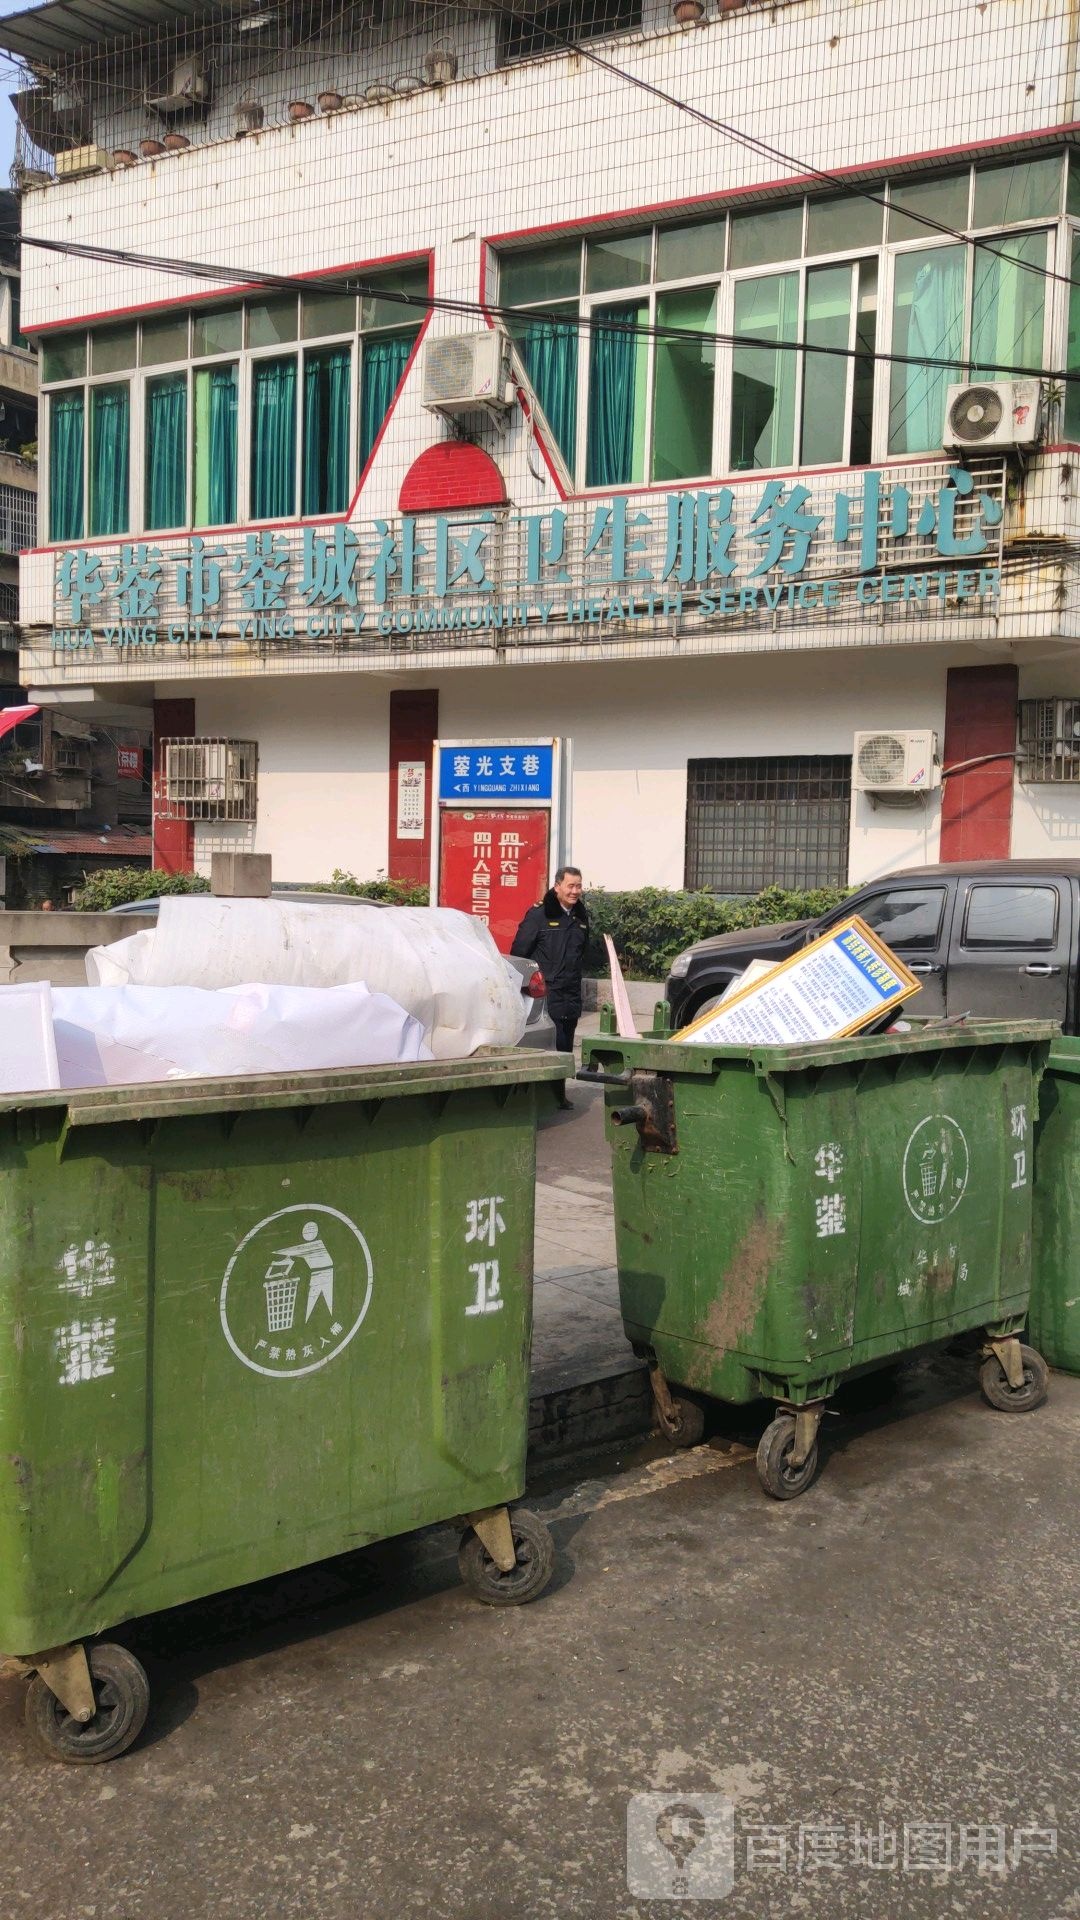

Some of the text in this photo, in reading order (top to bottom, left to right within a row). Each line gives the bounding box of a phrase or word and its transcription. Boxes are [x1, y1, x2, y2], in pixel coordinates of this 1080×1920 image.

[54, 467, 1003, 624] 华蓥市蓥城社区卫生服务中心
[51, 568, 1001, 650] HUA YING CITY YING CITY COMMUNITY HEALTH SERVICE CENTER
[454, 755, 539, 777] 蓥光支巷
[462, 783, 540, 793] 西 YINGGUANG ZHIXIANG
[500, 832, 520, 887] 四川农信
[1011, 1104, 1028, 1189] 环卫
[465, 1196, 507, 1316] 环卫
[254, 1322, 343, 1361] 严禁热灰入桶
